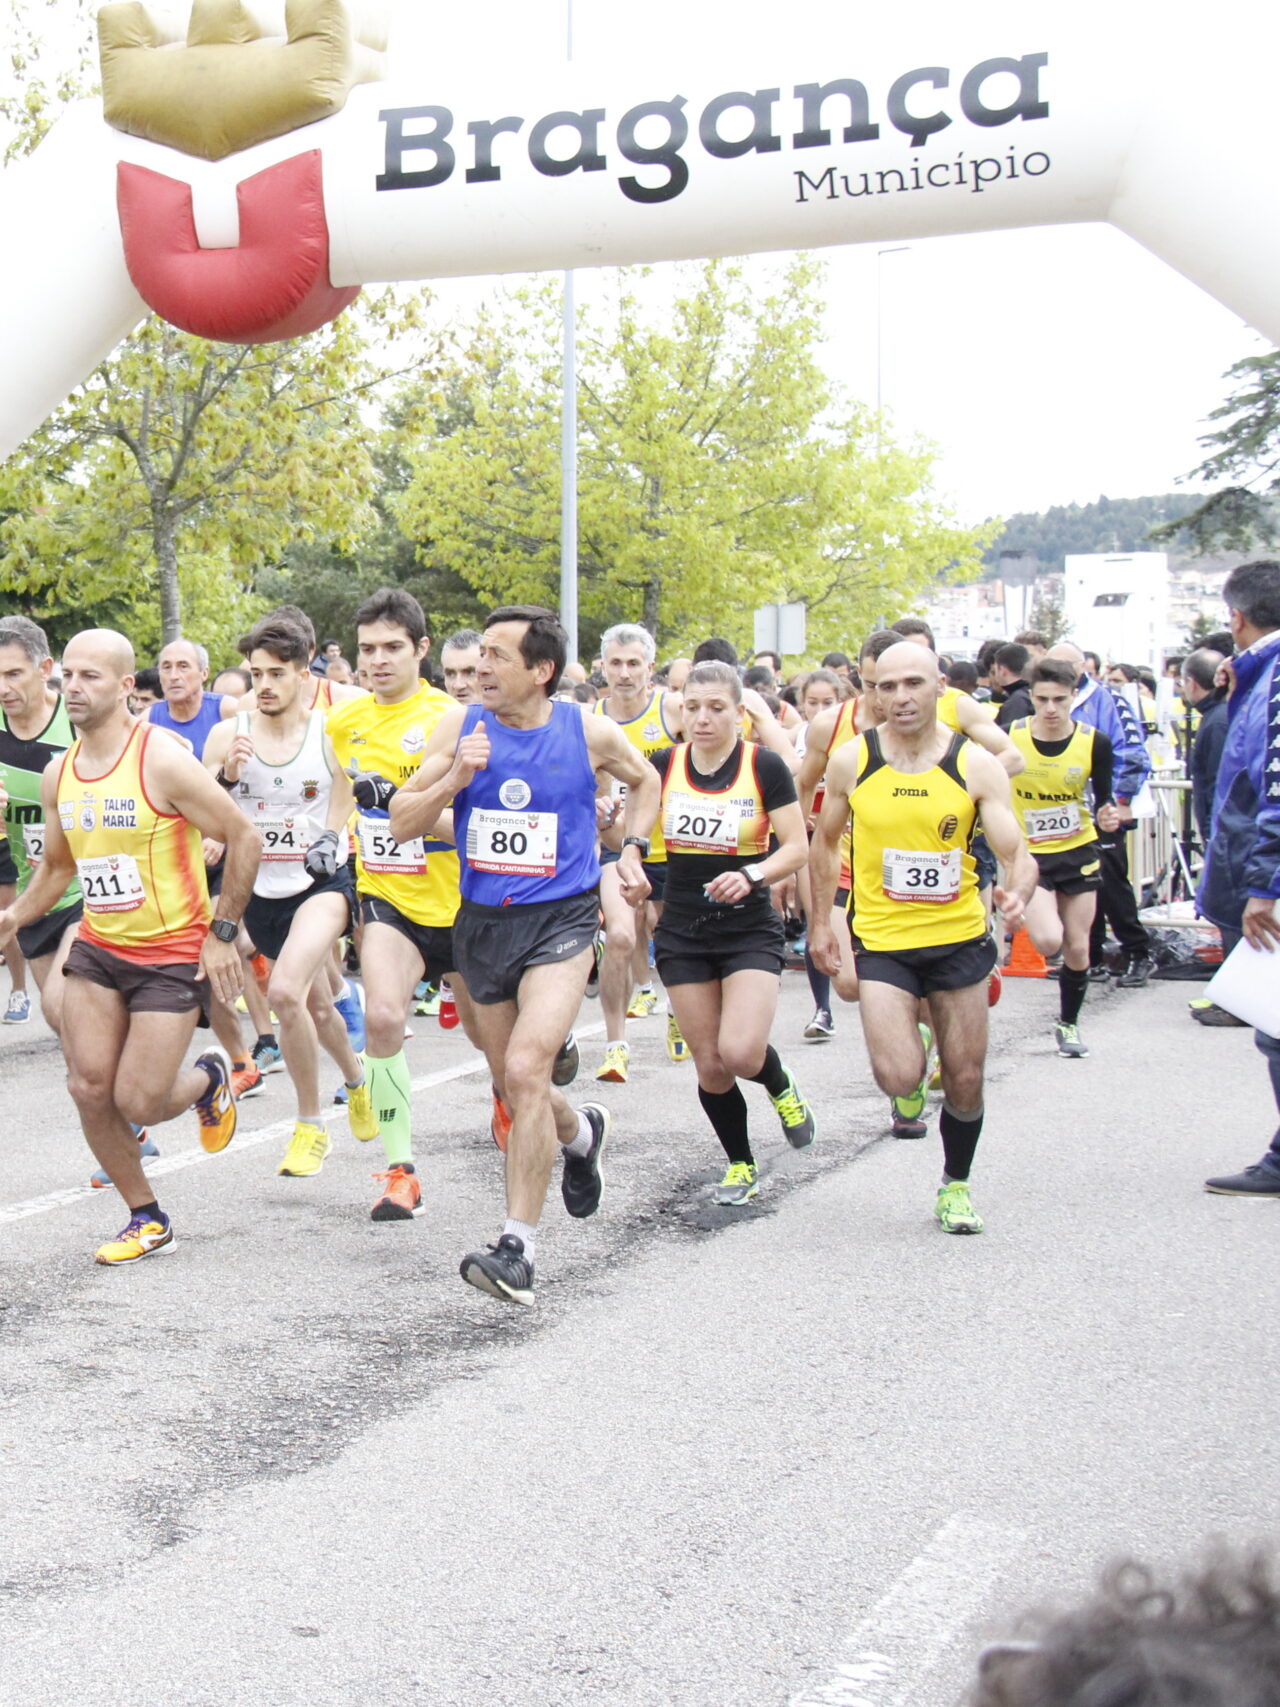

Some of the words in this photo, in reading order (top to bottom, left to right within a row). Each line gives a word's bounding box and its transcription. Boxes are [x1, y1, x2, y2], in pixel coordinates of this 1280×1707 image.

[375, 51, 1050, 205] Bragança
[793, 145, 1052, 203] Município
[104, 799, 135, 811] TALHO
[102, 815, 136, 827] MARIZ
[677, 815, 722, 838] 207
[1036, 816, 1070, 832] 220
[262, 831, 295, 848] 94
[373, 836, 401, 857] 52
[491, 831, 527, 855] 80
[84, 875, 125, 897] 211
[906, 868, 939, 887] 38
